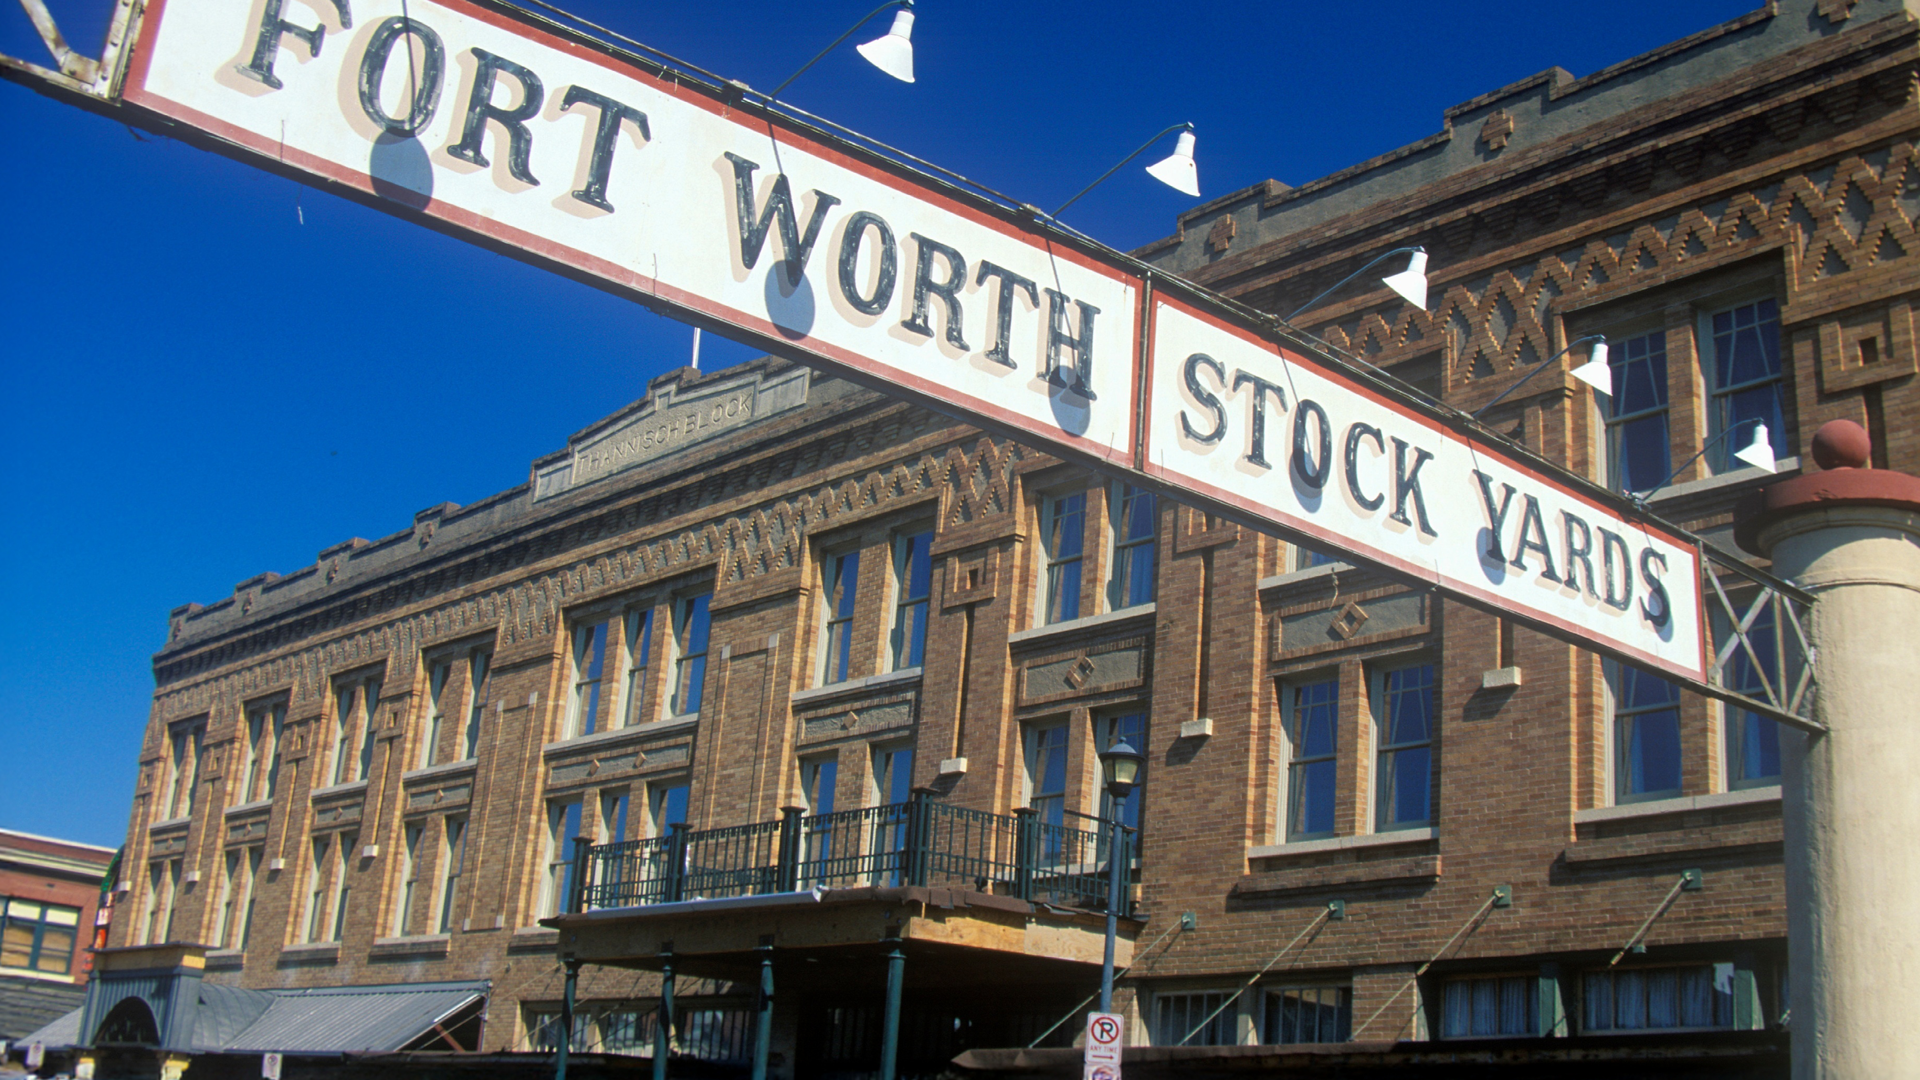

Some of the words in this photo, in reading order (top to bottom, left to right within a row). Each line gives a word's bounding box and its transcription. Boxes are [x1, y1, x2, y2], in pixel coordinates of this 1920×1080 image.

[233, 0, 652, 214] FORT
[723, 151, 1102, 401] WORTH
[579, 420, 680, 475] THANNISCH
[683, 392, 753, 435] BLOCK
[1180, 352, 1438, 538] STOCK
[1472, 468, 1672, 629] YARDS
[1103, 1046, 1118, 1054] TIME
